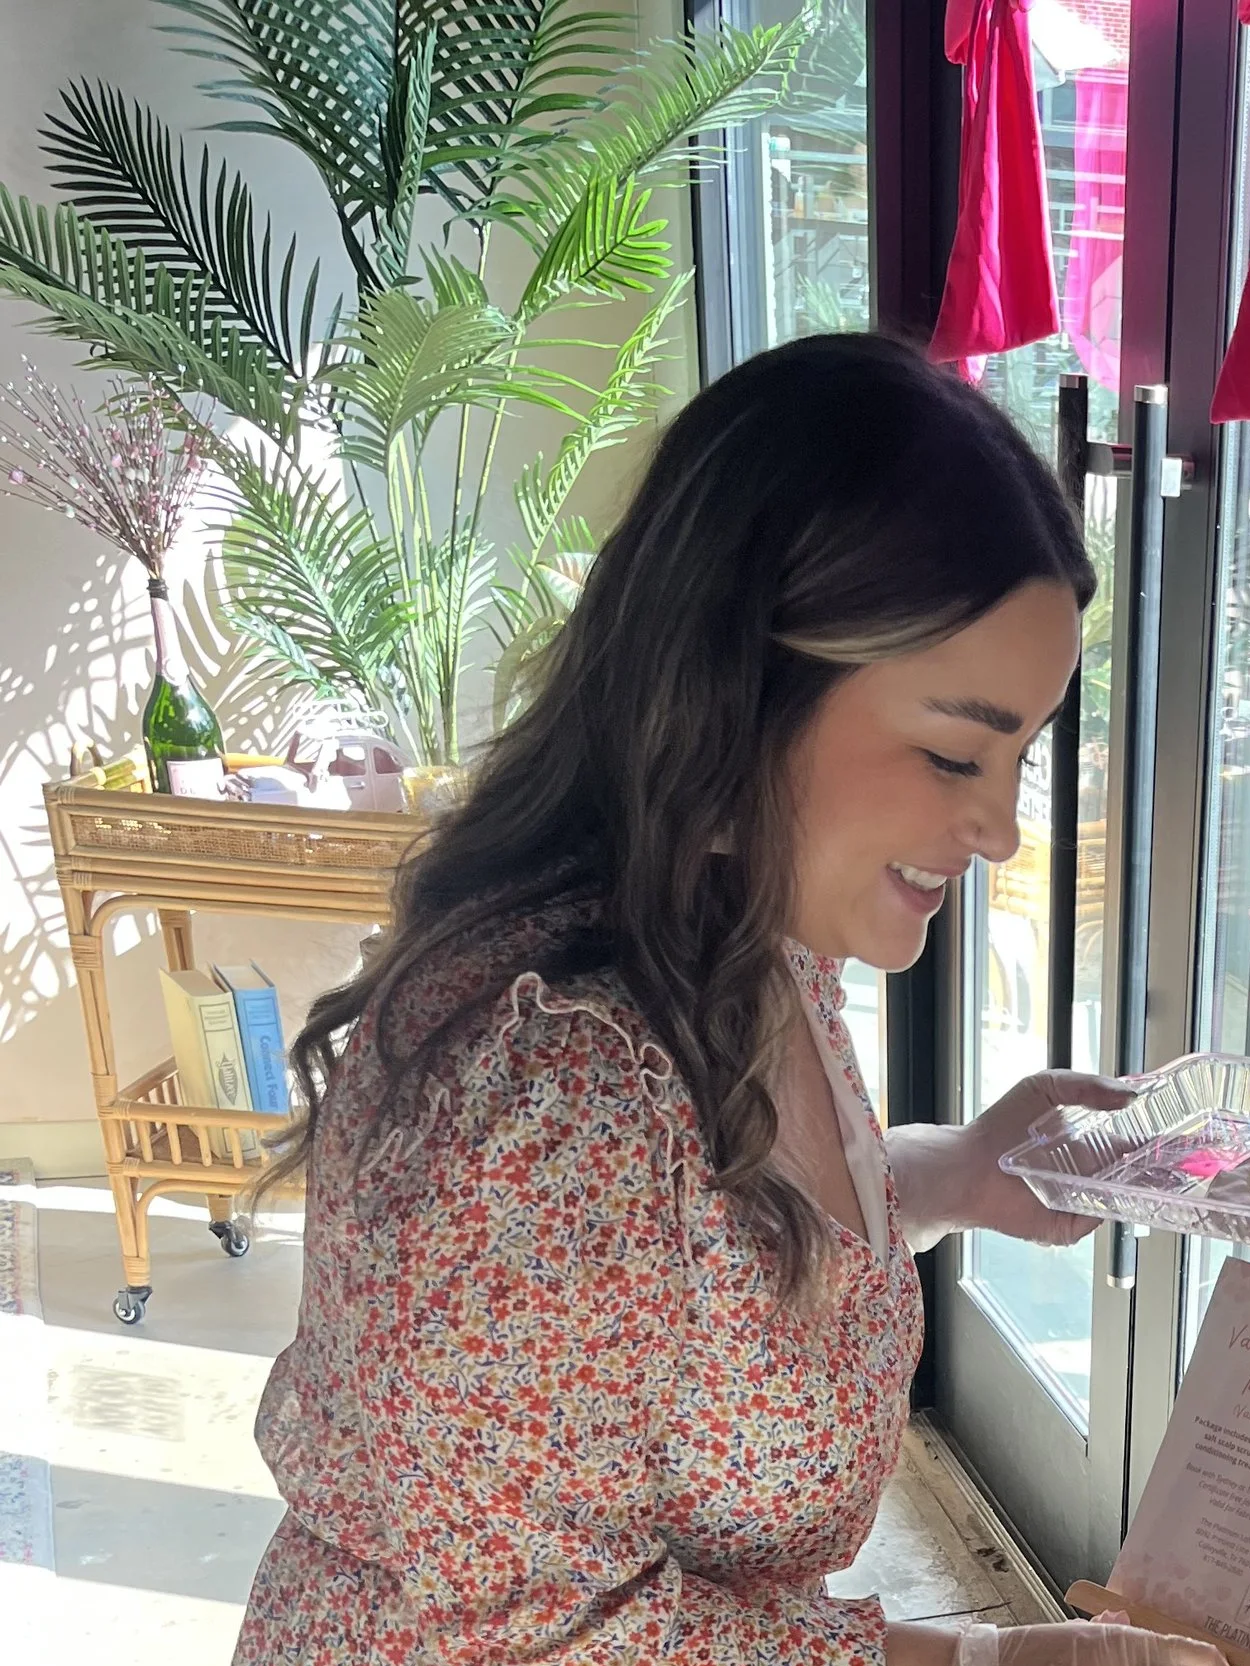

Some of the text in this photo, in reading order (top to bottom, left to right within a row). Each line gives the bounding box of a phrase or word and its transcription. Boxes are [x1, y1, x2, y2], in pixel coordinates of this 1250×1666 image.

[260, 1035, 278, 1109] Connect Four
[1195, 1416, 1222, 1433] Package
[1204, 1616, 1223, 1635] THE
